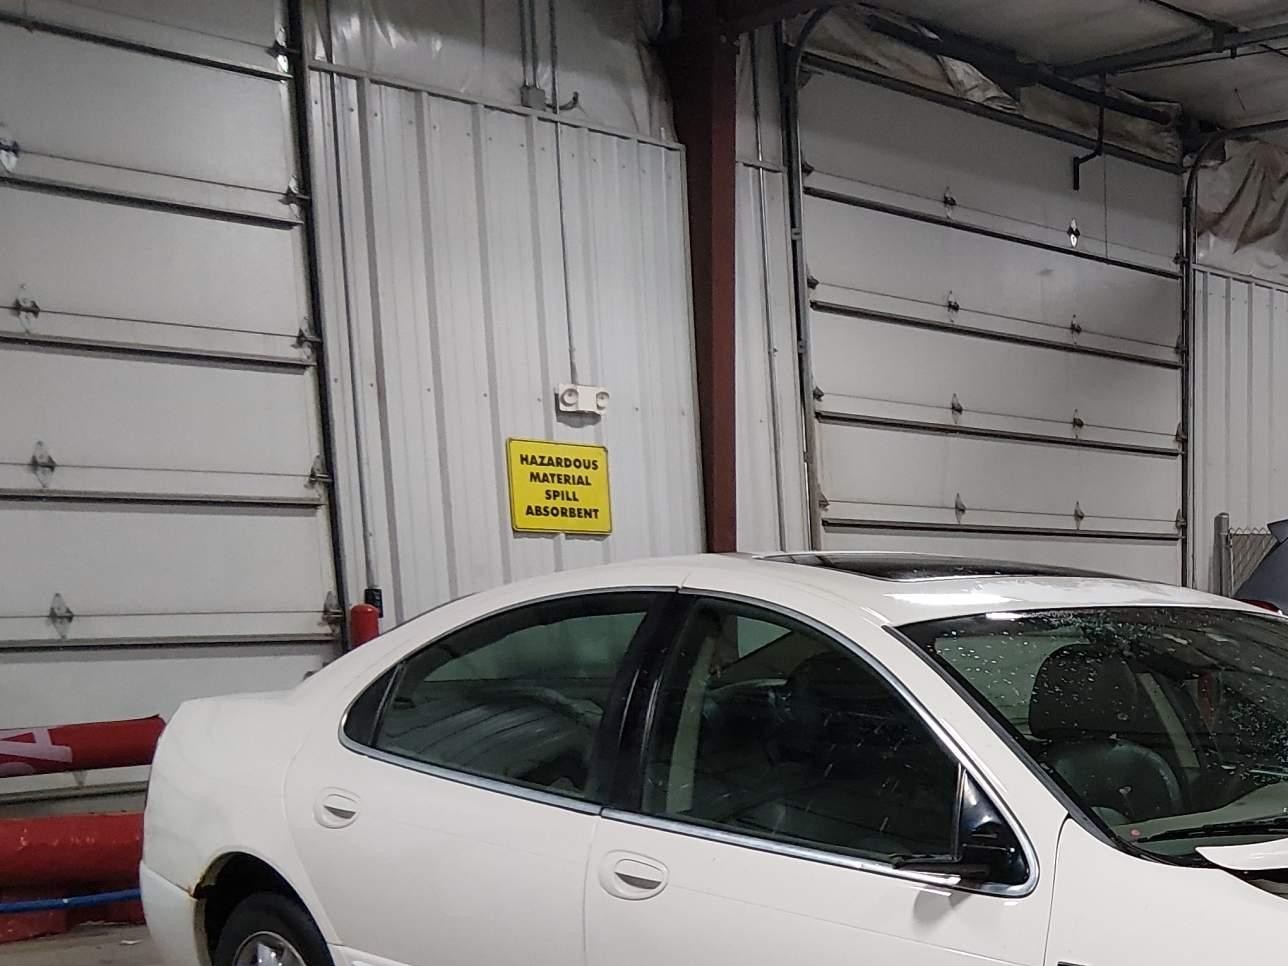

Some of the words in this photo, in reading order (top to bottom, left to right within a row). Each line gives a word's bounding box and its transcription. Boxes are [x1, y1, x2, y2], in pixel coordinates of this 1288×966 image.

[519, 453, 599, 470] HAZARDOUS
[529, 471, 592, 486] MATERIAL
[545, 489, 579, 502] SPILL
[525, 505, 599, 519] ABSORBENT
